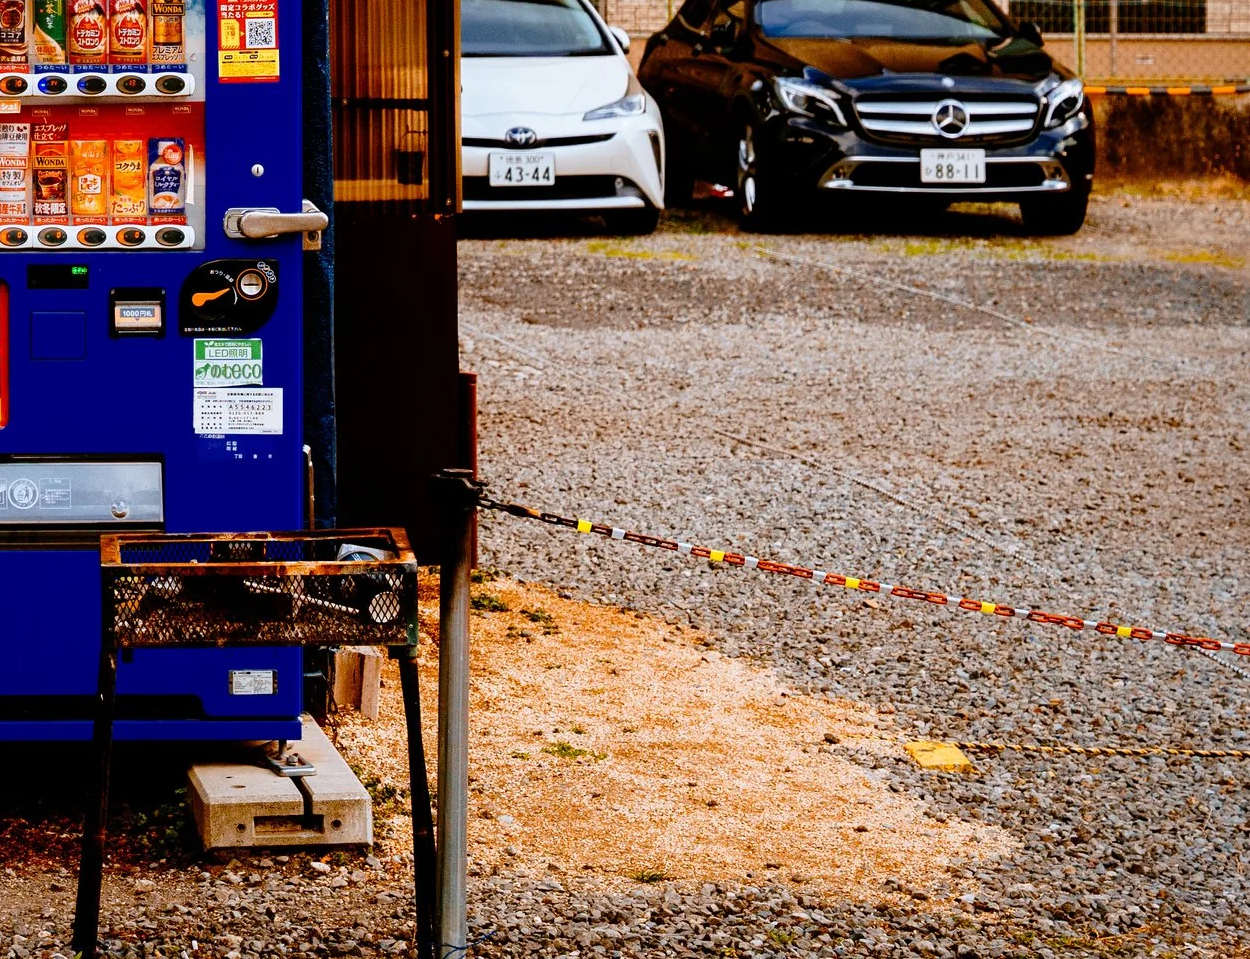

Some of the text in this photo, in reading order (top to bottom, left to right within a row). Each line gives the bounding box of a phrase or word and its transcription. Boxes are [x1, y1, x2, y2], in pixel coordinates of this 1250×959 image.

[153, 3, 183, 13] WONDA
[153, 46, 183, 54] プレミアム
[34, 124, 67, 132] エスプレッソ
[34, 133, 54, 141] 仕立て
[36, 156, 65, 166] WONDA
[115, 161, 141, 172] コクうま
[936, 164, 979, 179] 88-11
[2, 171, 22, 180] 特製
[505, 166, 550, 182] 43-44
[35, 202, 66, 214] 秋冬限定
[111, 200, 145, 214] たっぷり
[208, 348, 248, 358] LED照明
[210, 363, 262, 380] のむeco
